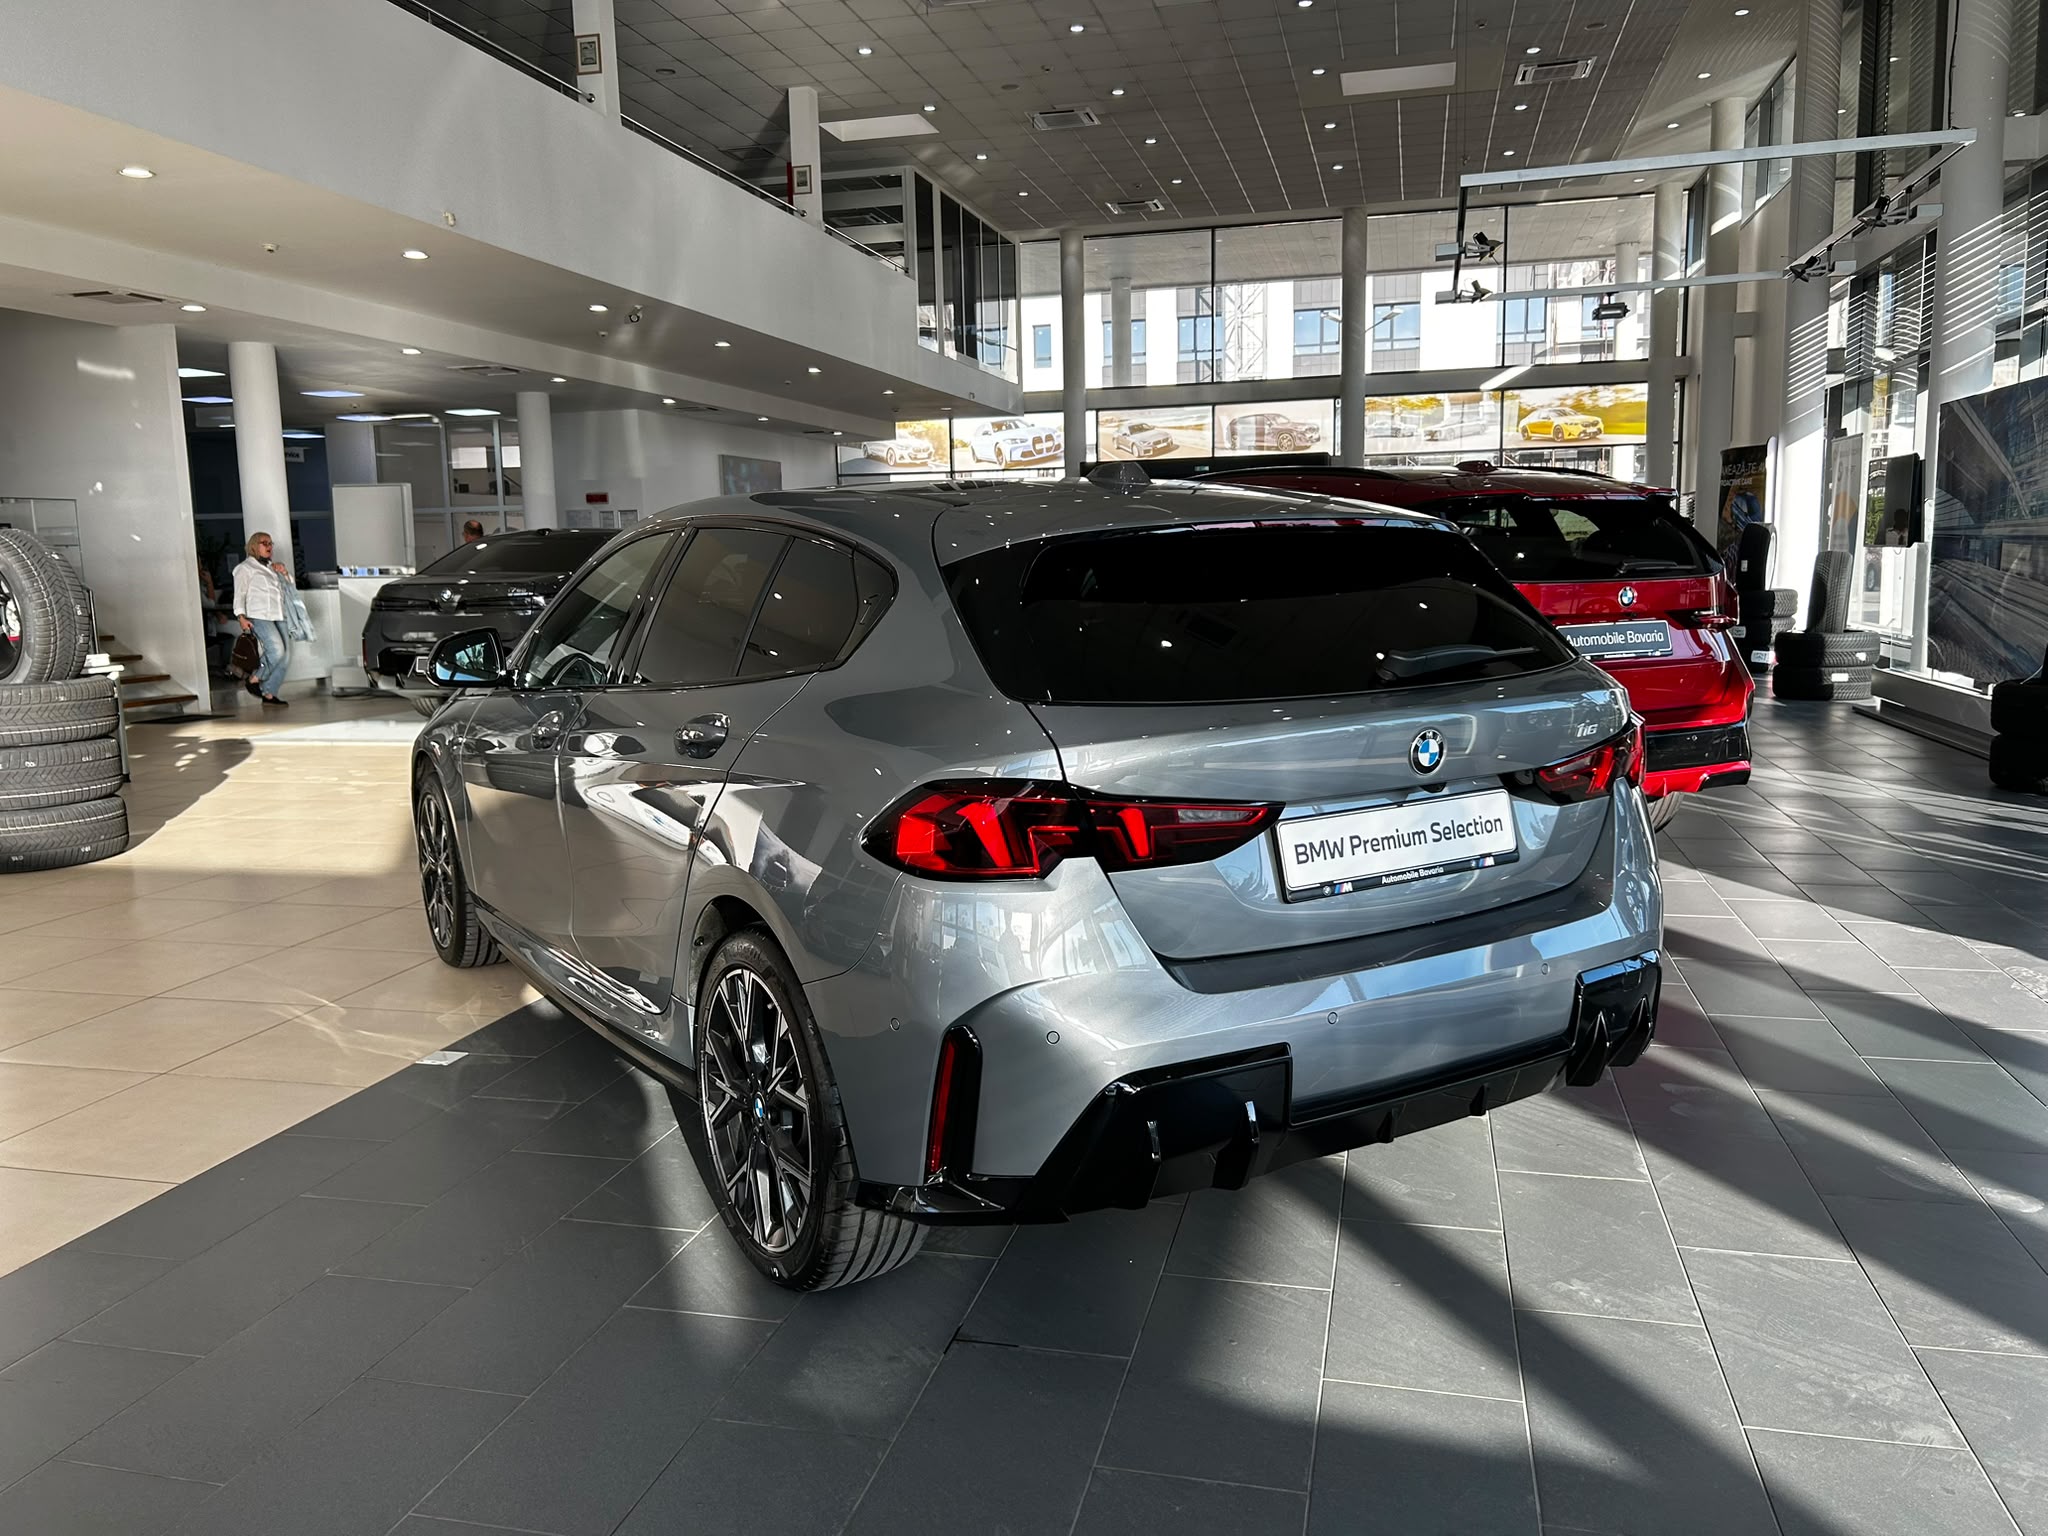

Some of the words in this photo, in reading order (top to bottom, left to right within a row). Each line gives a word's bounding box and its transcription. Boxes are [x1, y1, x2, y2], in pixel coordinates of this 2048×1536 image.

[1566, 631, 1625, 647] Automobile
[1626, 629, 1664, 644] Bavaria
[1294, 837, 1344, 865] BMW
[1349, 828, 1428, 856] Premium
[1430, 815, 1503, 843] Selection
[1381, 870, 1419, 885] Automobile
[1420, 866, 1444, 877] Bavaria
